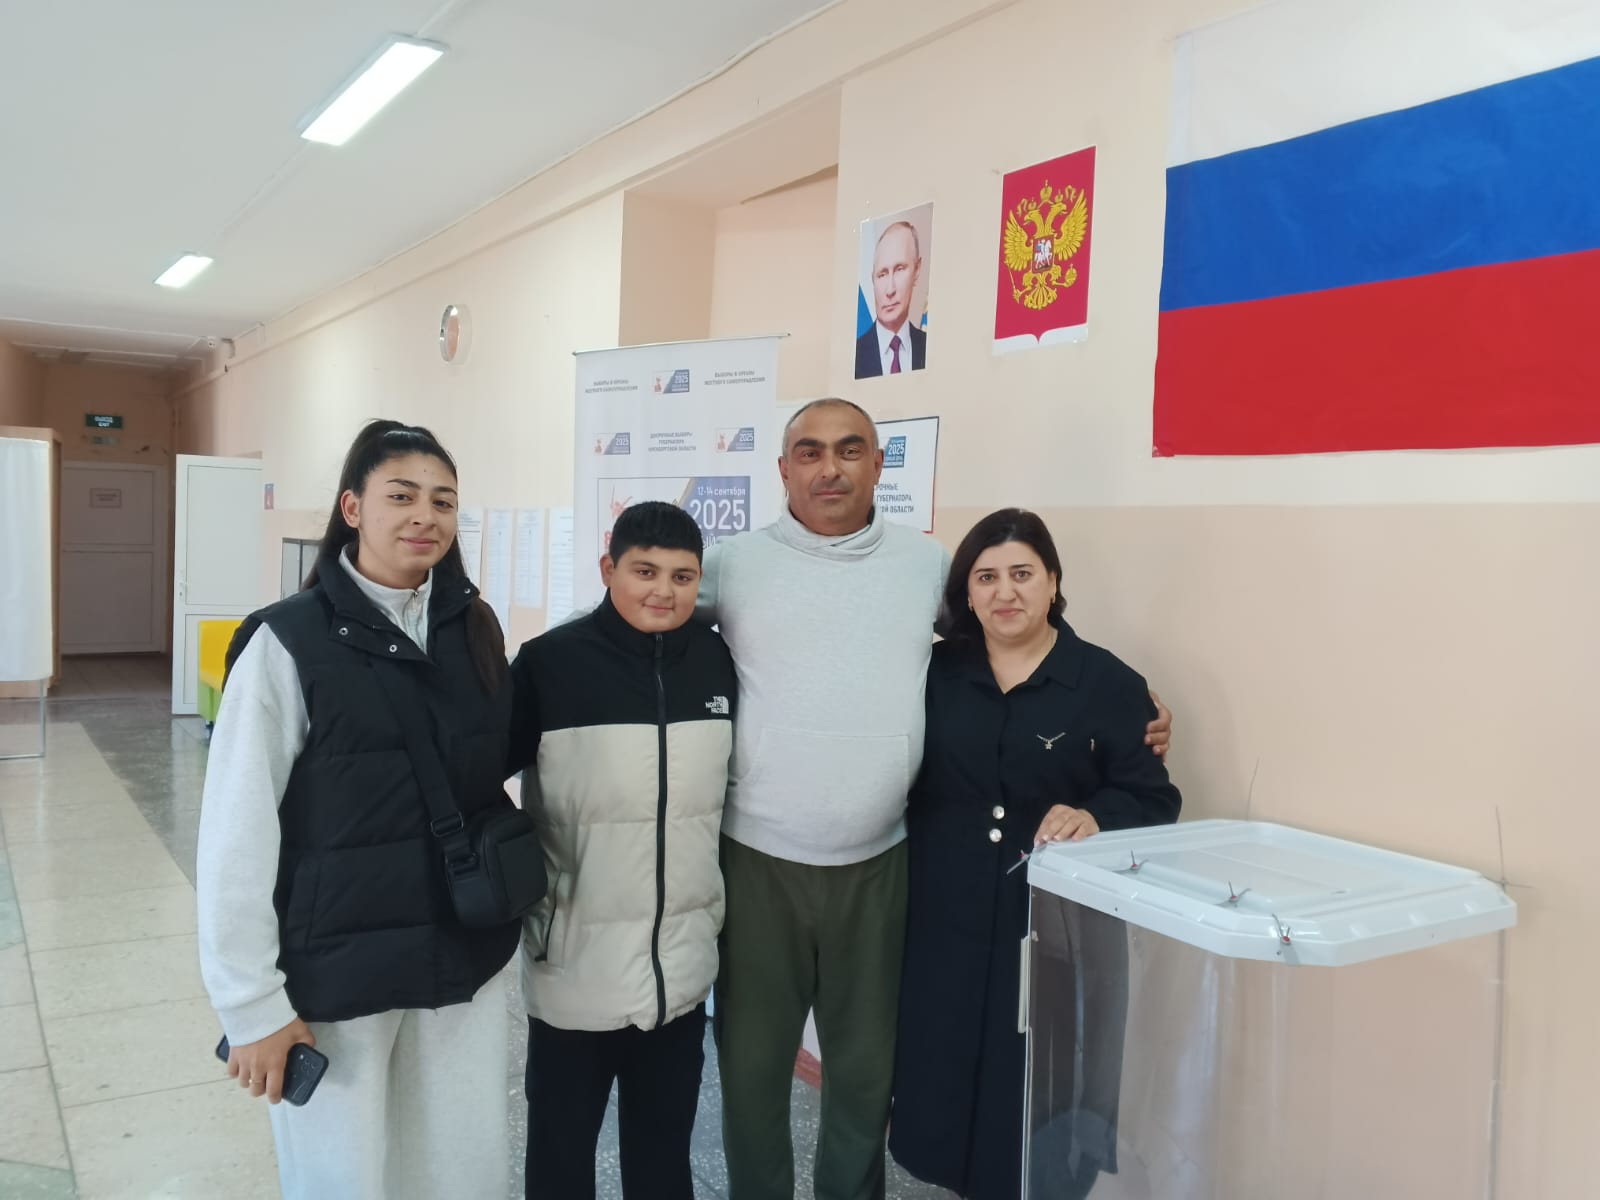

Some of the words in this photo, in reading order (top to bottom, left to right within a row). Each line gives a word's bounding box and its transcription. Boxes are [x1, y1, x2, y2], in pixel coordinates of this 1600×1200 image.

[888, 443, 905, 456] 2025
[697, 486, 713, 496] 12-14
[714, 486, 746, 497] сентября
[876, 494, 912, 503] ГУБЕРНАТОРА
[889, 505, 914, 513] ОБЛАСТИ
[690, 499, 746, 531] 2025
